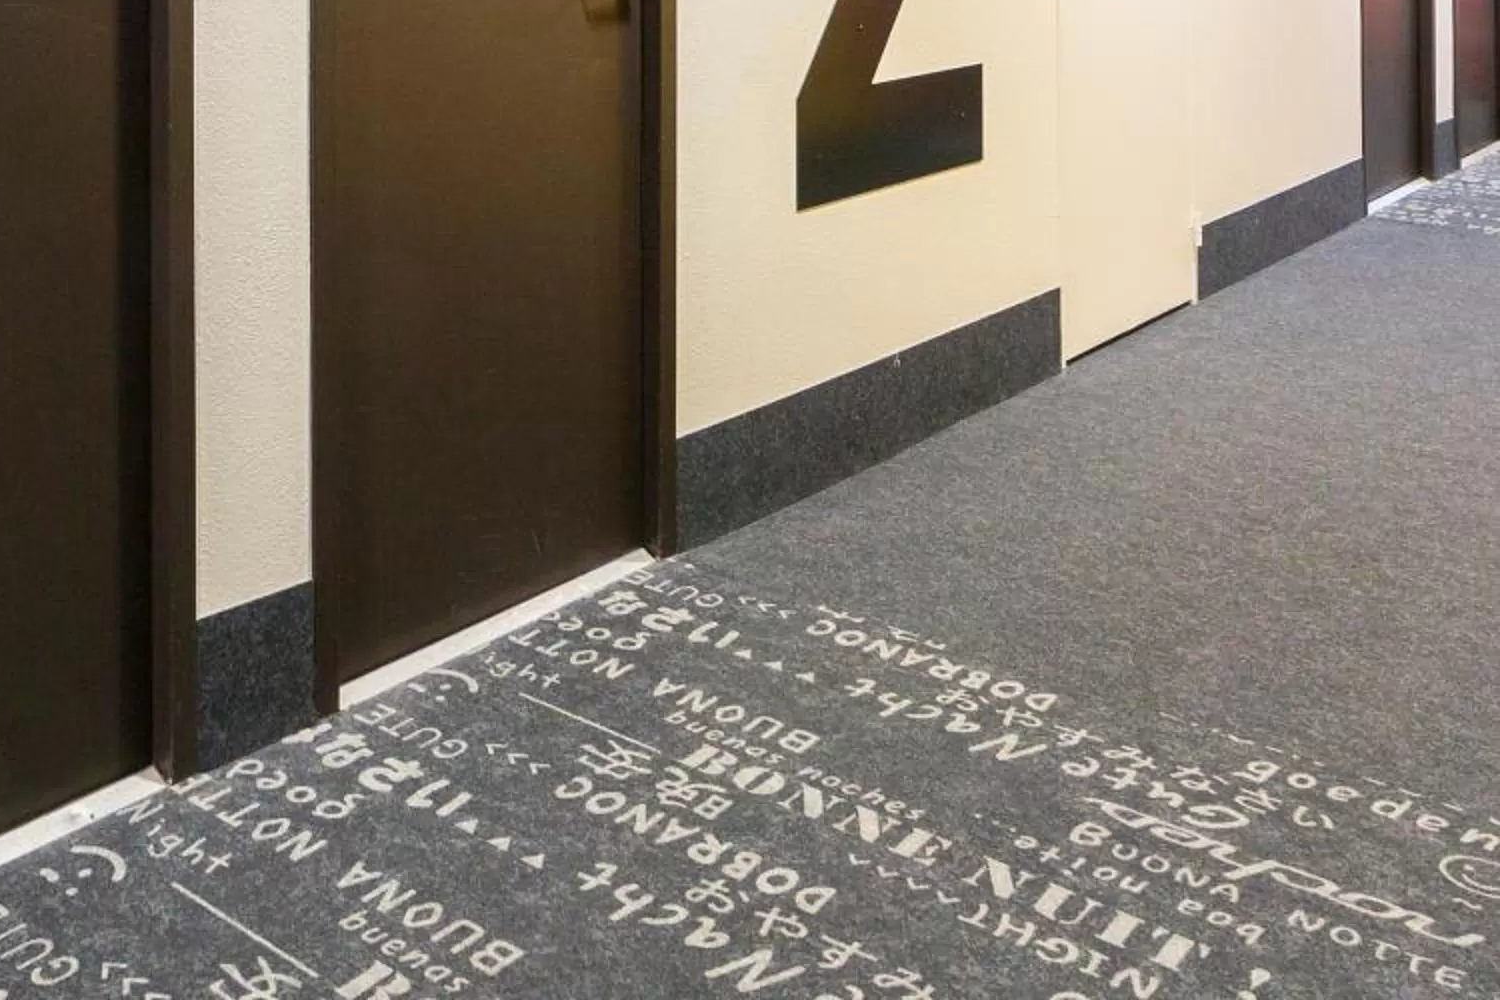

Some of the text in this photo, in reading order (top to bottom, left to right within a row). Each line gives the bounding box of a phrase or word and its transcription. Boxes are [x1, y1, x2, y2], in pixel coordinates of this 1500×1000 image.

[617, 567, 724, 607] GUTE
[479, 651, 560, 688] ight
[807, 620, 1057, 711] DOBRANOC
[353, 703, 468, 758] GUTE
[653, 678, 820, 753] BUONA
[845, 678, 1250, 829] Gute Nacht
[664, 710, 925, 820] buenas noches
[114, 793, 232, 874] Night
[555, 776, 836, 914] DOBRANOC
[678, 744, 952, 866] BONNE
[962, 856, 1210, 971] NUIT
[337, 862, 525, 975] BUONA
[339, 910, 470, 992] buenas
[578, 862, 805, 992] Nacht
[958, 904, 1160, 1000] NIGHT
[1177, 898, 1264, 949] boa
[1287, 909, 1466, 989] NOTTE
